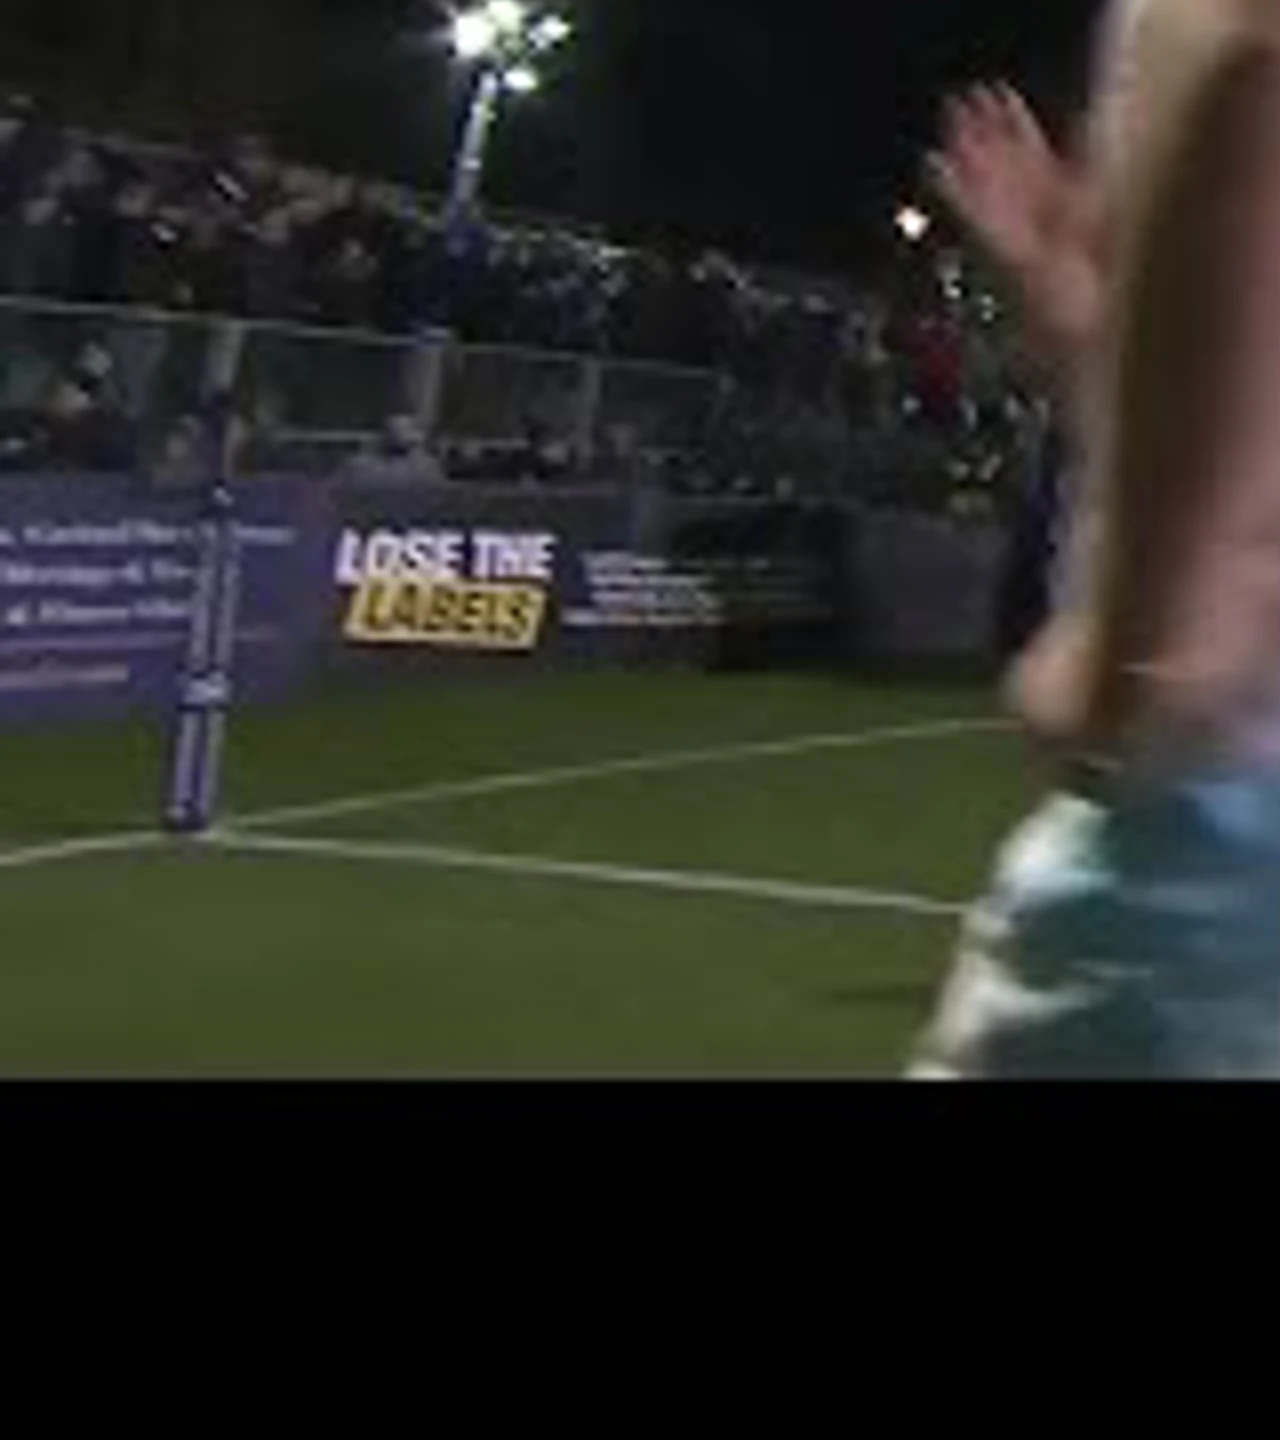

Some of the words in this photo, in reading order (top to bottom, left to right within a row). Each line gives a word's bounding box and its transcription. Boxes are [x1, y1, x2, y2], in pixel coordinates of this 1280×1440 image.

[336, 526, 465, 584] LOSE
[472, 528, 558, 581] THE
[363, 582, 536, 638] LABELS
